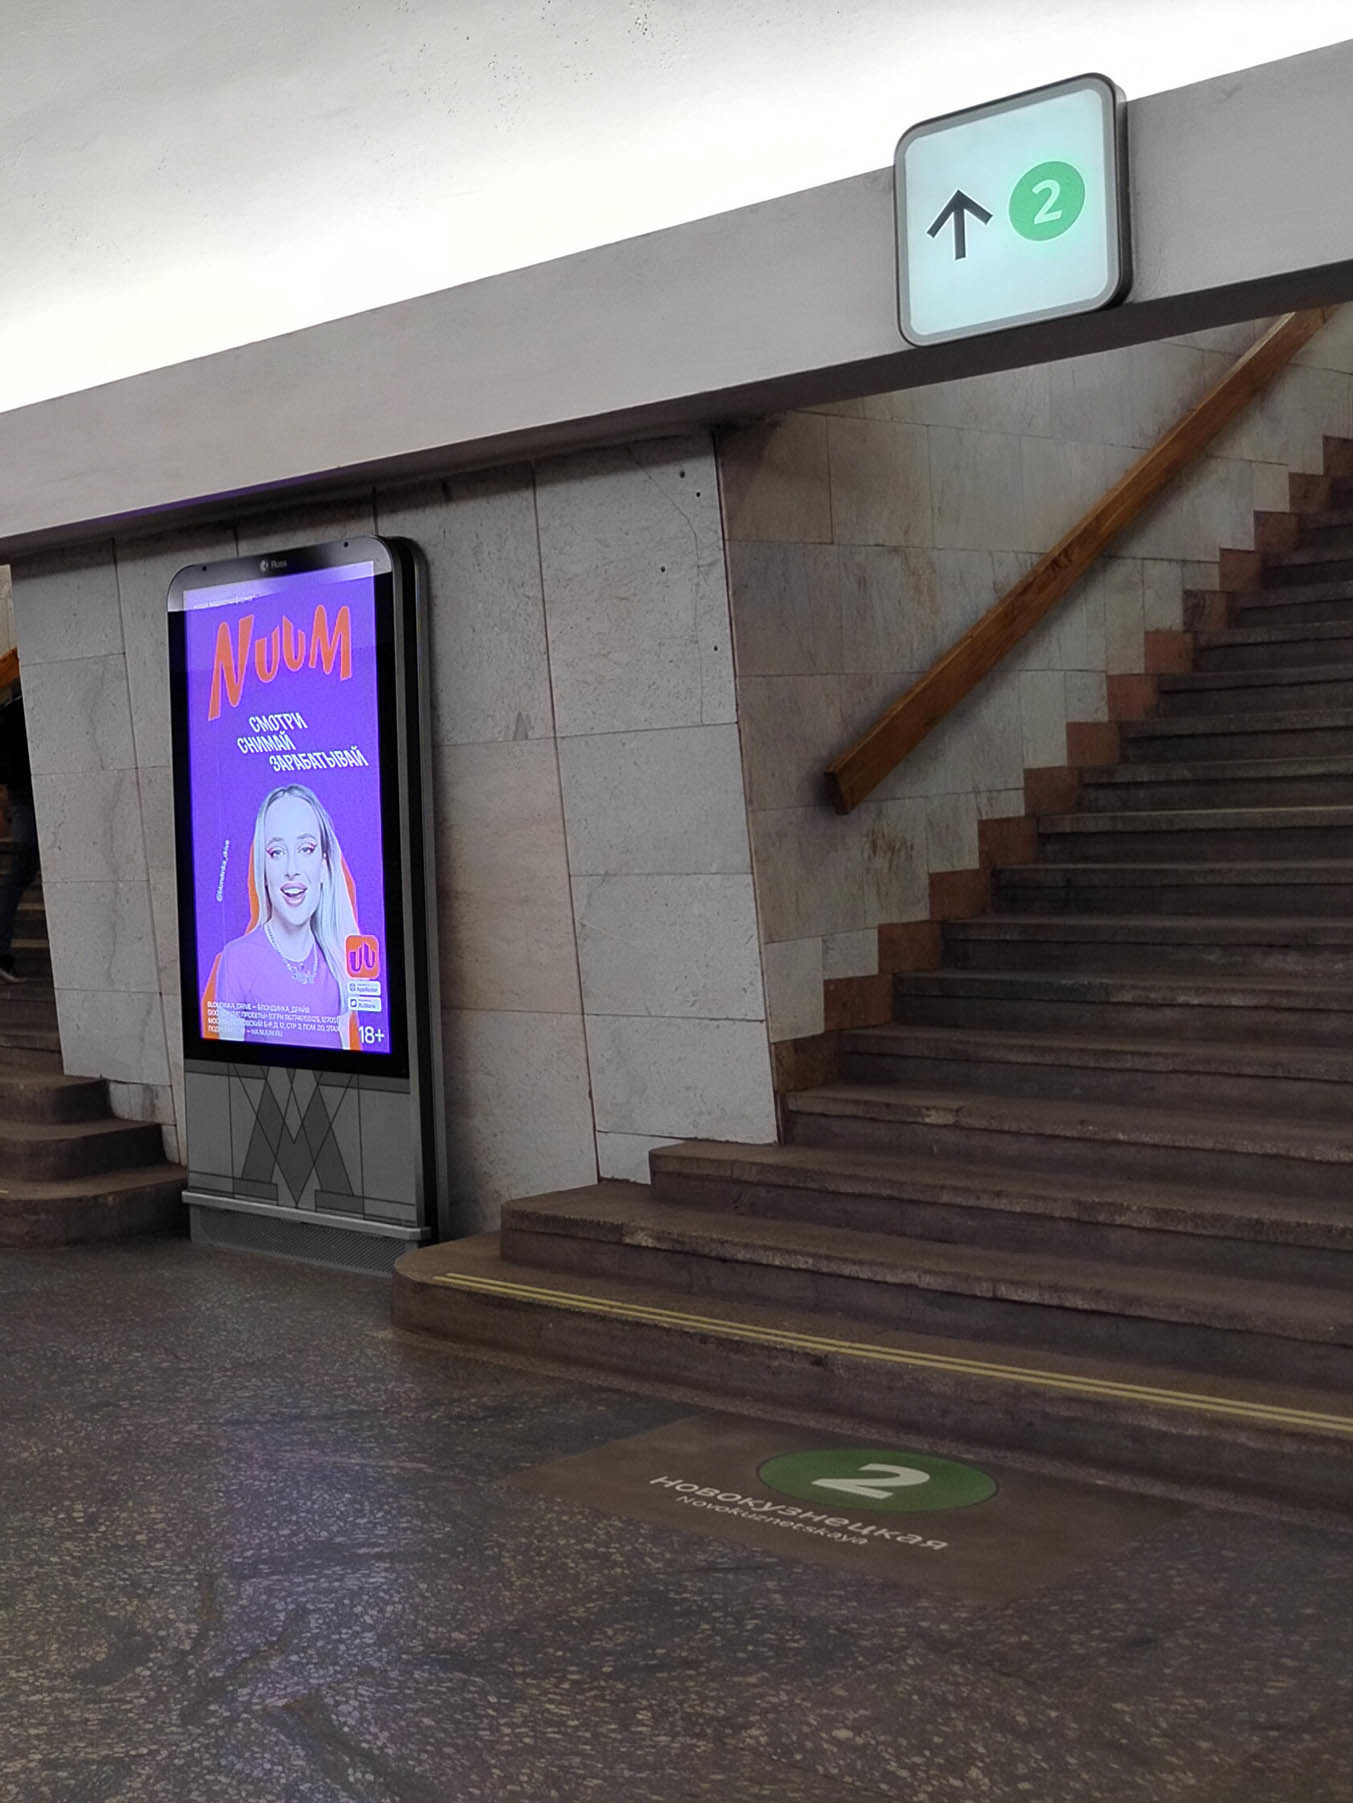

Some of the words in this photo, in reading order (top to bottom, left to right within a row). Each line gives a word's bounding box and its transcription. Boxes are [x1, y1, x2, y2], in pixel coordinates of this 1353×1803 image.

[1031, 179, 1063, 225] 2
[249, 712, 308, 733] СМОТРИ
[236, 731, 296, 755] СНИМАЙ
[269, 745, 369, 772] ЗАРАБАТЫВАЙ
[358, 1025, 385, 1044] 18+
[810, 1463, 931, 1500] 2
[649, 1474, 949, 1551] Новокузнецкая
[676, 1495, 869, 1546] Novokuznetskaya
